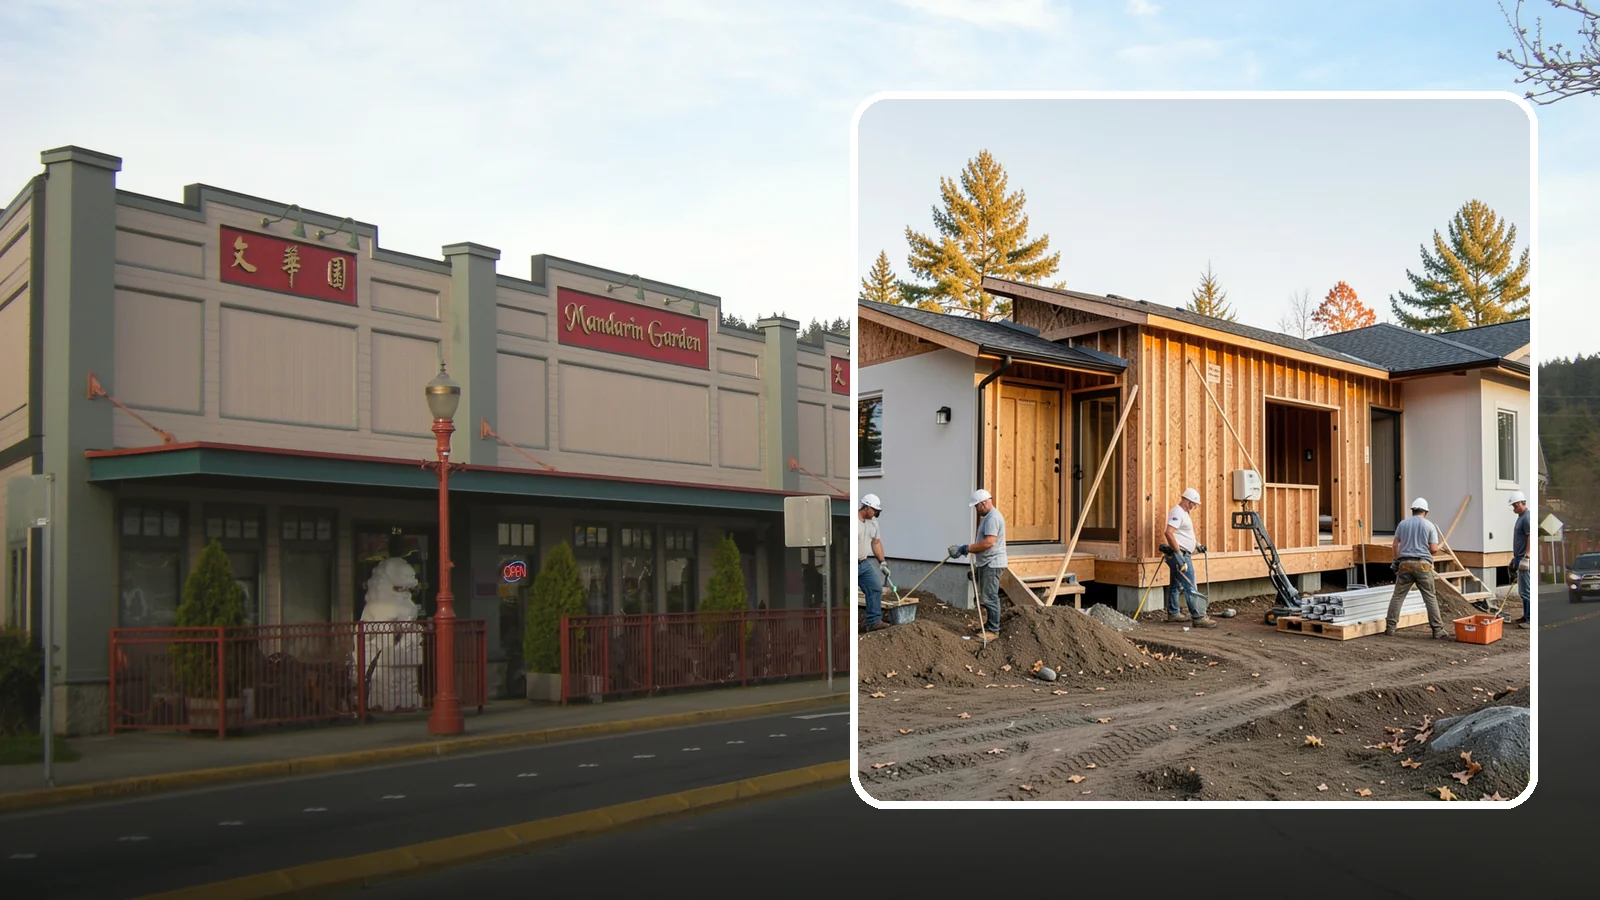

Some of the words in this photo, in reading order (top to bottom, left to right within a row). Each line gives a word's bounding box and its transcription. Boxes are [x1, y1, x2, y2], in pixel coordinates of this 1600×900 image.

[231, 236, 346, 291] 文華園
[564, 302, 644, 341] Mandarin
[647, 320, 702, 352] Garden
[835, 363, 846, 386] 文
[503, 565, 527, 578] OPEN
